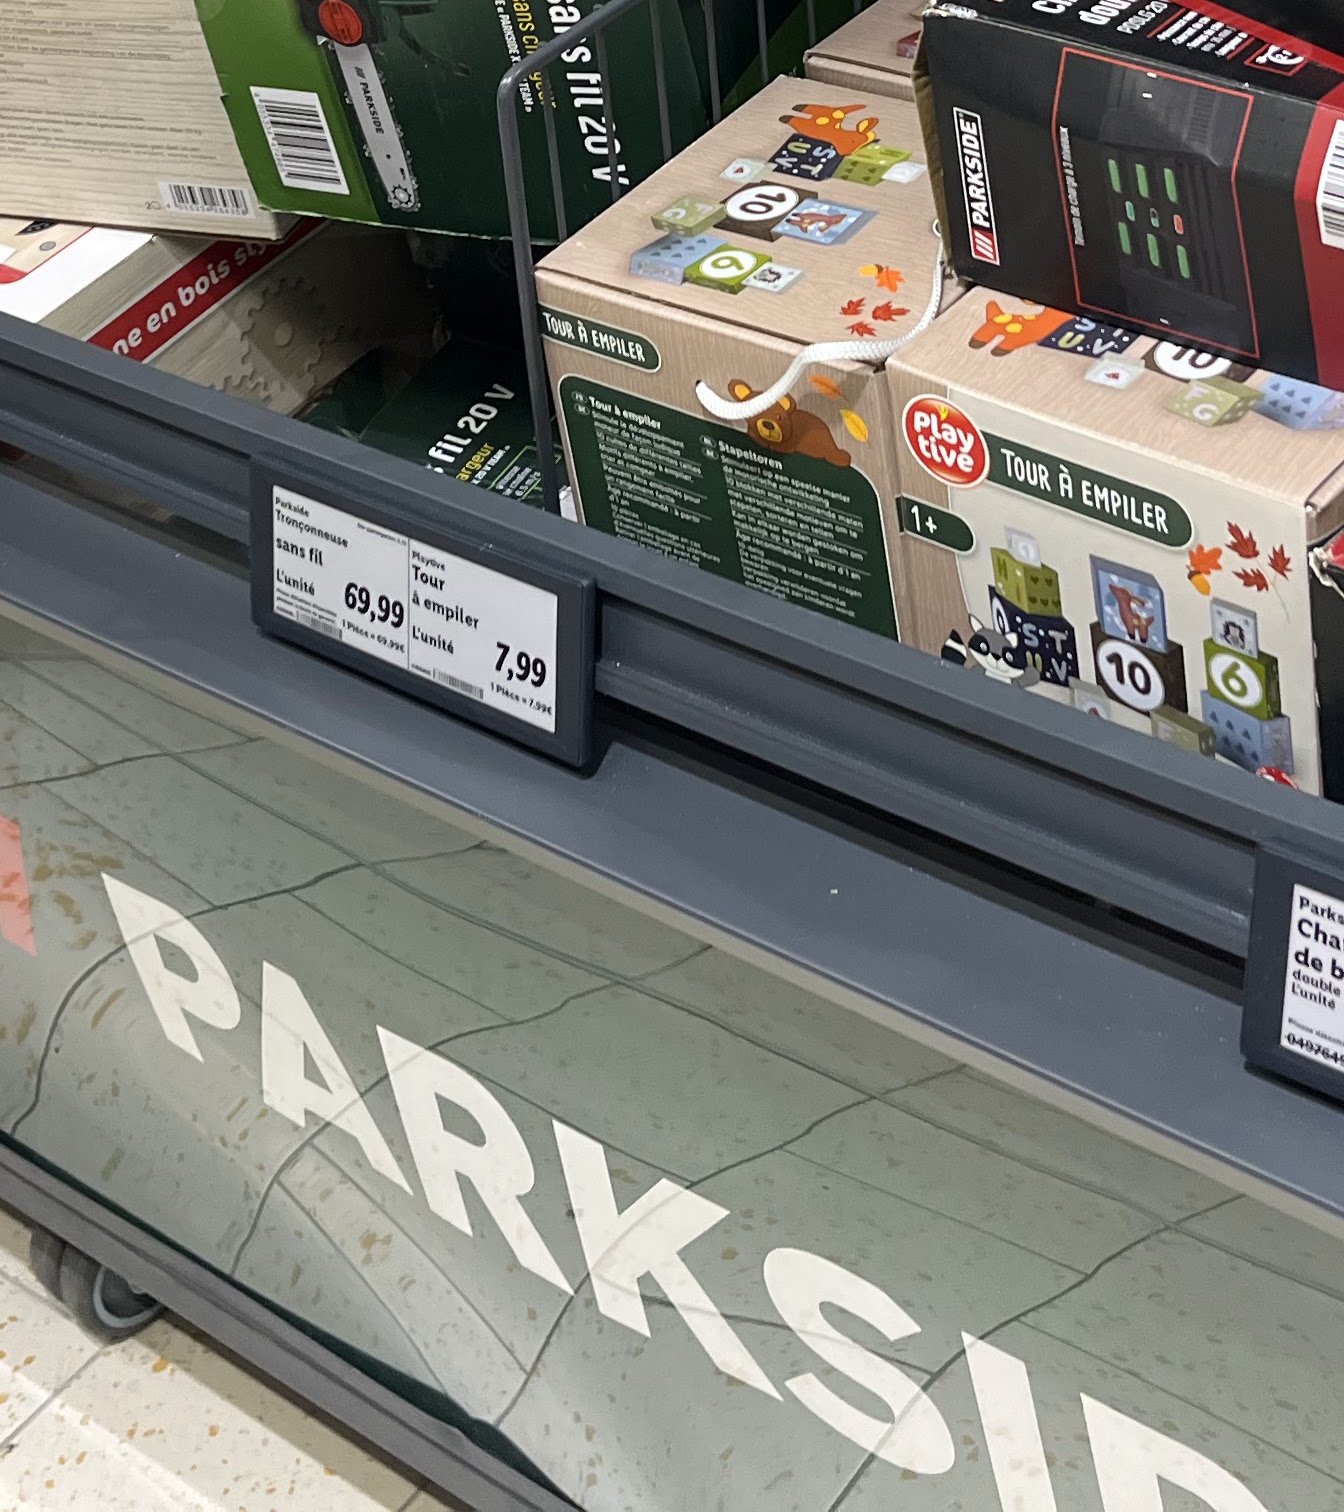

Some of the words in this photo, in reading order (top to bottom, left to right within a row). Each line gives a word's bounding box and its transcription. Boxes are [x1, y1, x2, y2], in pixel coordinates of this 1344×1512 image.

[360, 82, 384, 135] PARKSIDE
[962, 113, 990, 228] PARKSIDE
[542, 312, 575, 340] TOUR
[578, 320, 589, 344] À
[592, 330, 645, 362] EMPILER
[913, 410, 975, 454] Play
[917, 435, 974, 473] tive
[1001, 448, 1051, 492] TOUR
[1058, 465, 1073, 500] À
[1082, 480, 1170, 535] EMPILER
[276, 509, 348, 548] Tronçonneuse
[276, 538, 306, 558] sans
[309, 547, 324, 566] fil
[412, 564, 445, 591] Tour
[276, 568, 315, 596] L'unité
[344, 582, 404, 628] 69,99
[412, 590, 420, 605] à
[424, 599, 479, 629] empiler
[412, 625, 454, 655] L'unité
[495, 641, 546, 687] 7,99
[1294, 947, 1323, 972] de
[1291, 982, 1336, 1011] L'unité
[1292, 969, 1341, 998] double
